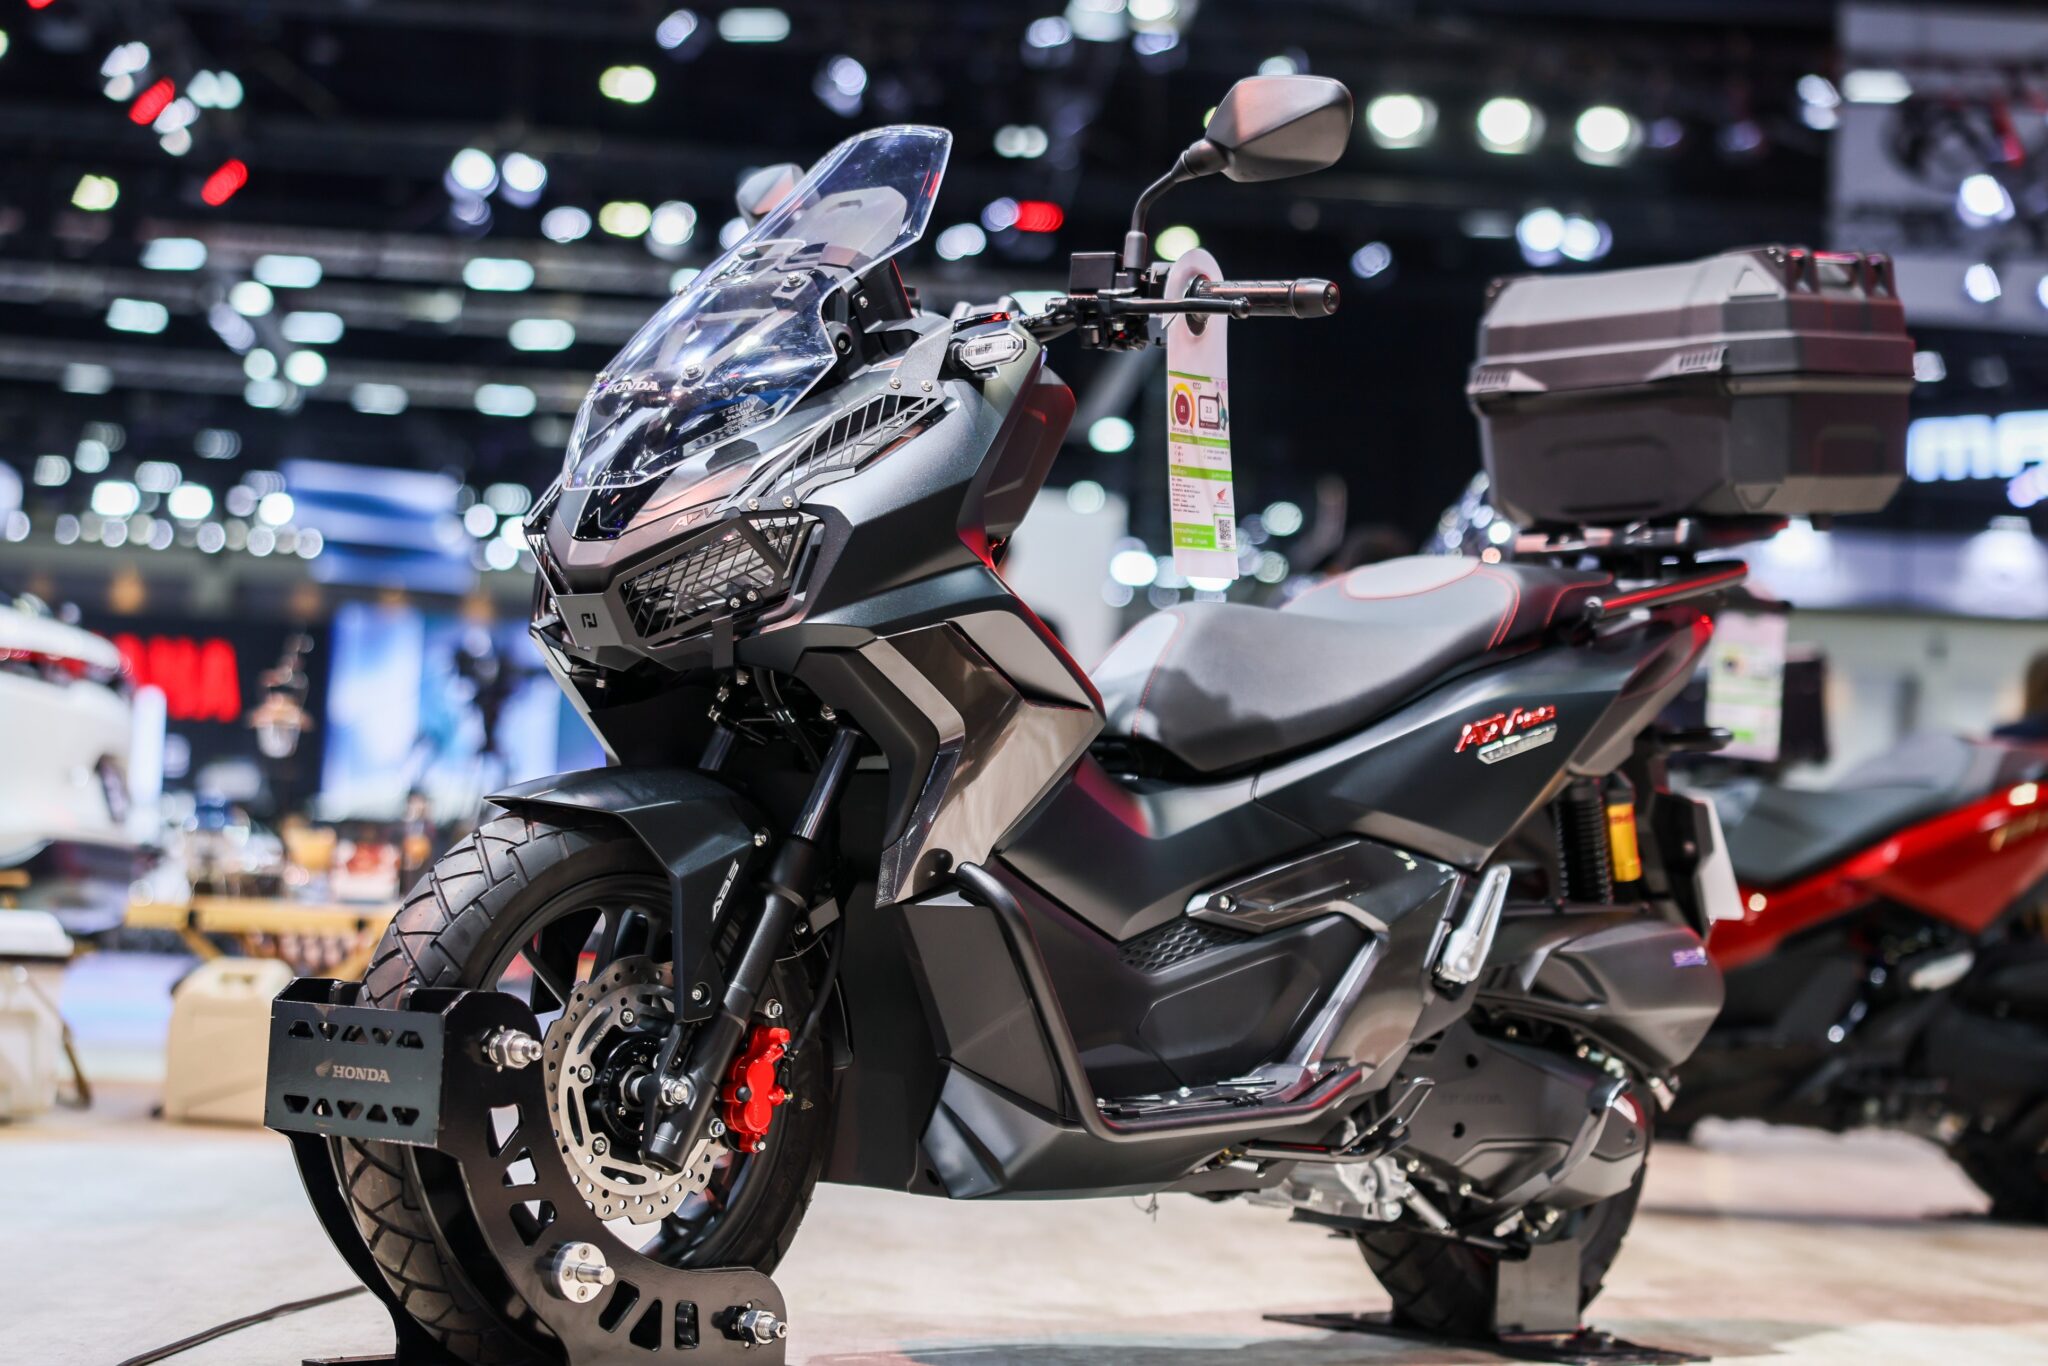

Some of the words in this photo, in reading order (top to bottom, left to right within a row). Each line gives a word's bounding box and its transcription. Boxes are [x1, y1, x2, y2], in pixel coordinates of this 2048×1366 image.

[607, 380, 660, 393] HONDA
[668, 503, 722, 532] ADV
[711, 857, 740, 923] ABS
[332, 1064, 391, 1083] HONDA
